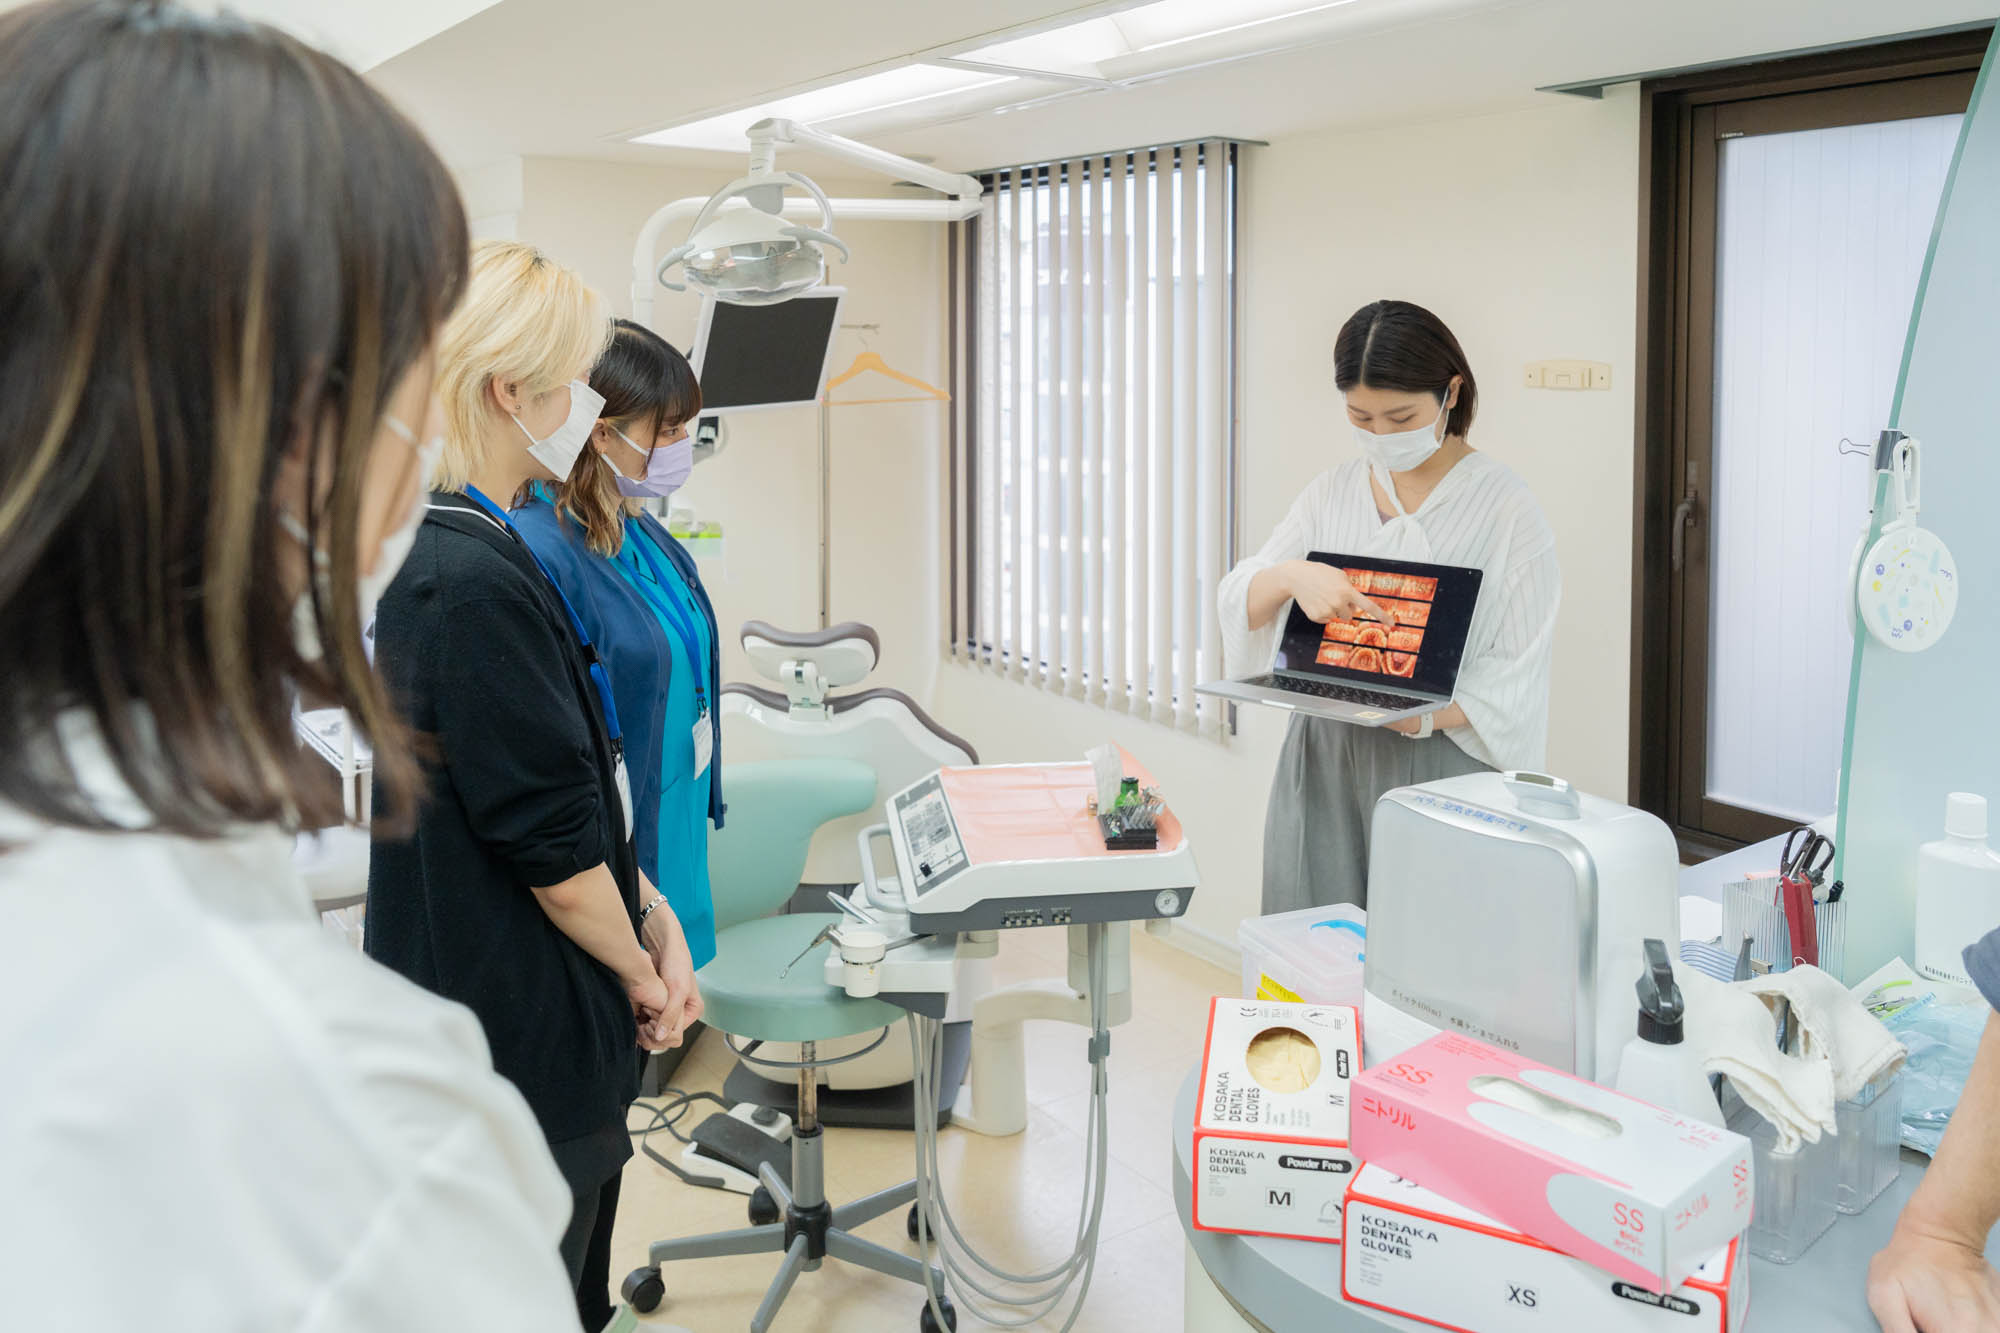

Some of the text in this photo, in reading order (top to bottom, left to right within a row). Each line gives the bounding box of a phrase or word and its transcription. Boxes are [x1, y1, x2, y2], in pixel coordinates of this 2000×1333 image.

[1387, 1063, 1433, 1084] SS
[1213, 1071, 1230, 1121] KOSAKA
[1229, 1088, 1243, 1122] DENTAL
[1246, 1087, 1260, 1123] GLOVES
[1329, 1094, 1344, 1106] M
[1361, 1097, 1416, 1131] ニトリル
[1209, 1148, 1265, 1160] KOSAKA
[1209, 1156, 1246, 1166] DENTAL
[1287, 1157, 1344, 1171] Powder Free
[1209, 1165, 1247, 1175] GLOVES
[1269, 1190, 1291, 1206] M
[1613, 1202, 1644, 1232] SS
[1361, 1214, 1439, 1243] KOSAKA
[1361, 1226, 1412, 1247] DENTAL
[1361, 1238, 1412, 1260] GLOVES
[1508, 1285, 1536, 1307] XS
